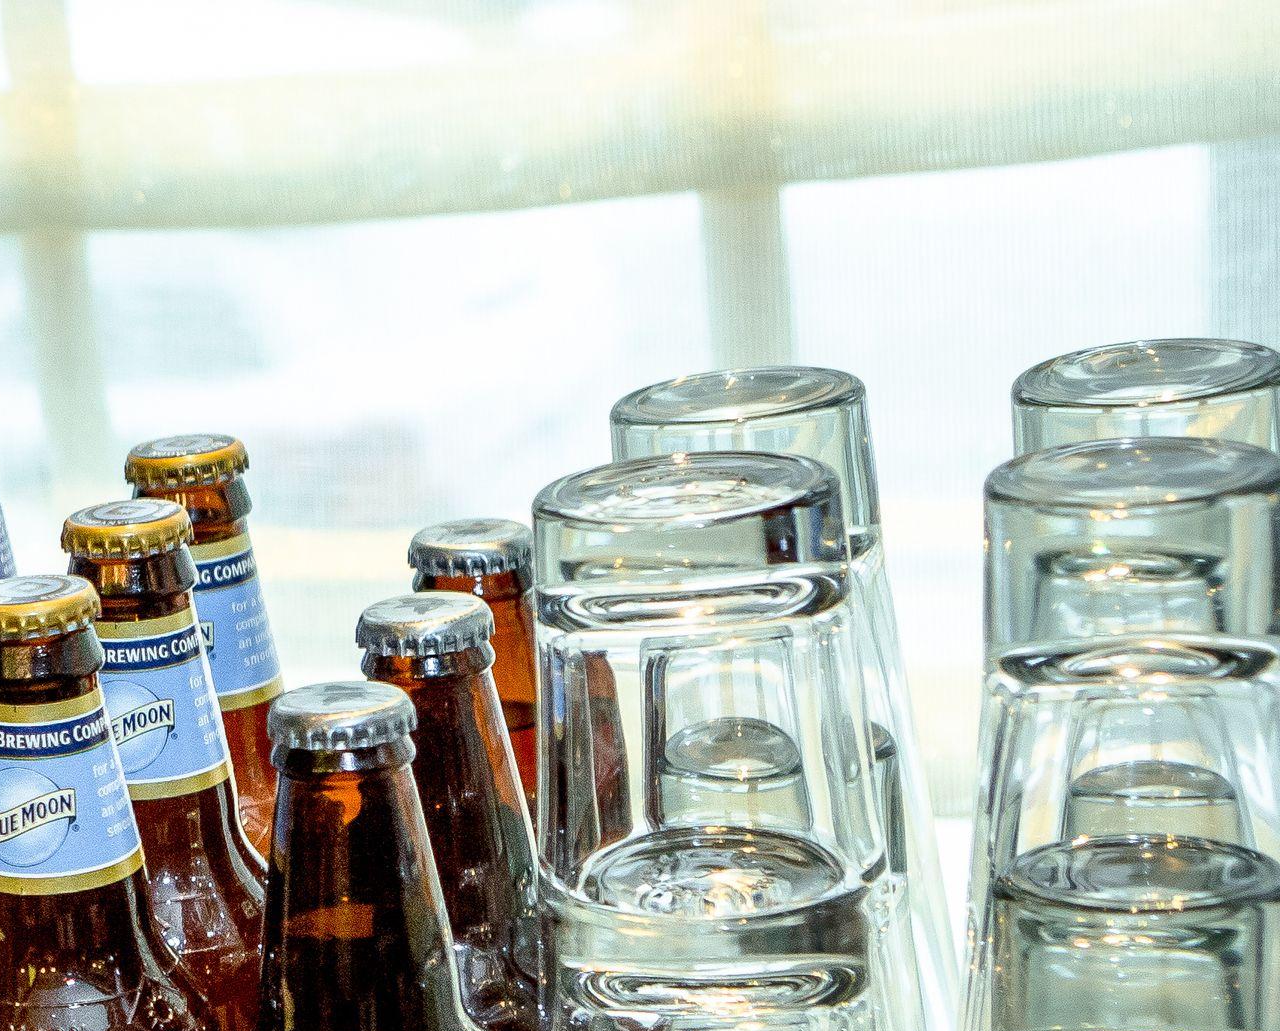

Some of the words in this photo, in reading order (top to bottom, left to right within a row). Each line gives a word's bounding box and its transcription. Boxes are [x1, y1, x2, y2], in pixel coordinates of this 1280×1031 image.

[171, 634, 200, 656] COMP
[72, 714, 109, 741] COMP
[122, 702, 172, 734] MOON
[21, 793, 74, 824] MOON
